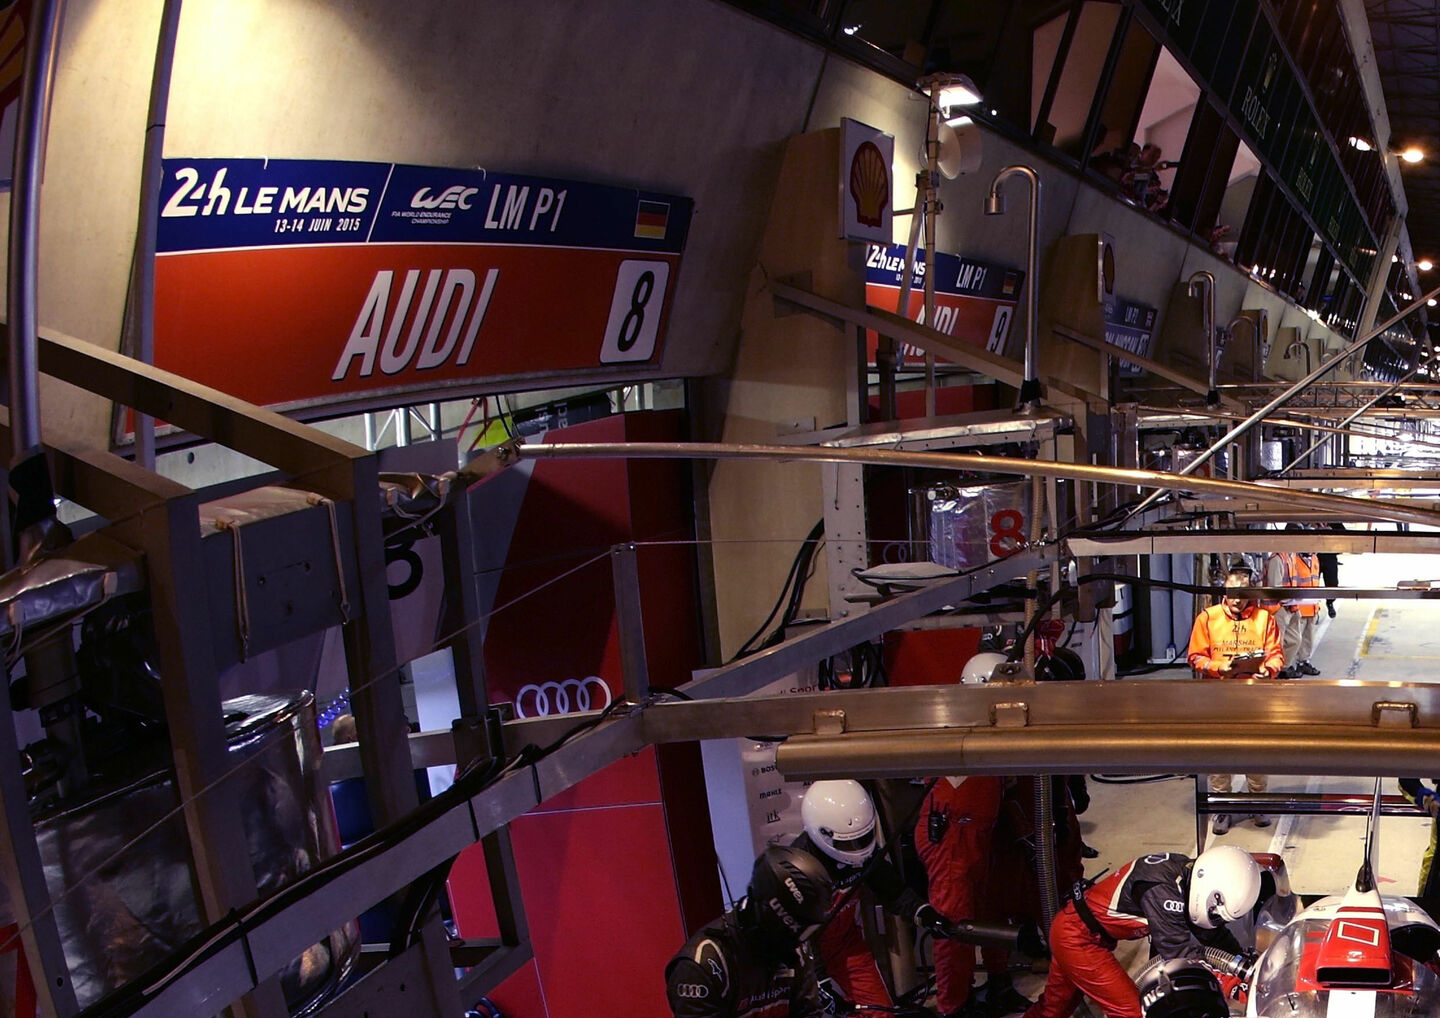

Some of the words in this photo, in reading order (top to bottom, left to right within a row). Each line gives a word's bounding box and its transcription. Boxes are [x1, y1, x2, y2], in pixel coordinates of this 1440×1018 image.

[1241, 86, 1271, 140] ROLEX
[161, 167, 231, 217] 24h
[234, 187, 279, 214] LE
[279, 187, 370, 214] MANS
[411, 185, 479, 210] WEC
[484, 184, 529, 230] LM
[529, 187, 568, 232] P1
[274, 218, 303, 233] 13-14
[308, 218, 332, 232] JUIN
[336, 218, 361, 232] 2015
[886, 256, 900, 271] LE
[956, 264, 975, 289] LM
[971, 266, 988, 291] P1
[331, 268, 499, 381] AUDI
[617, 270, 655, 352] 8
[990, 509, 1026, 558] 8
[784, 877, 804, 904] uvex
[769, 897, 800, 934] uvex
